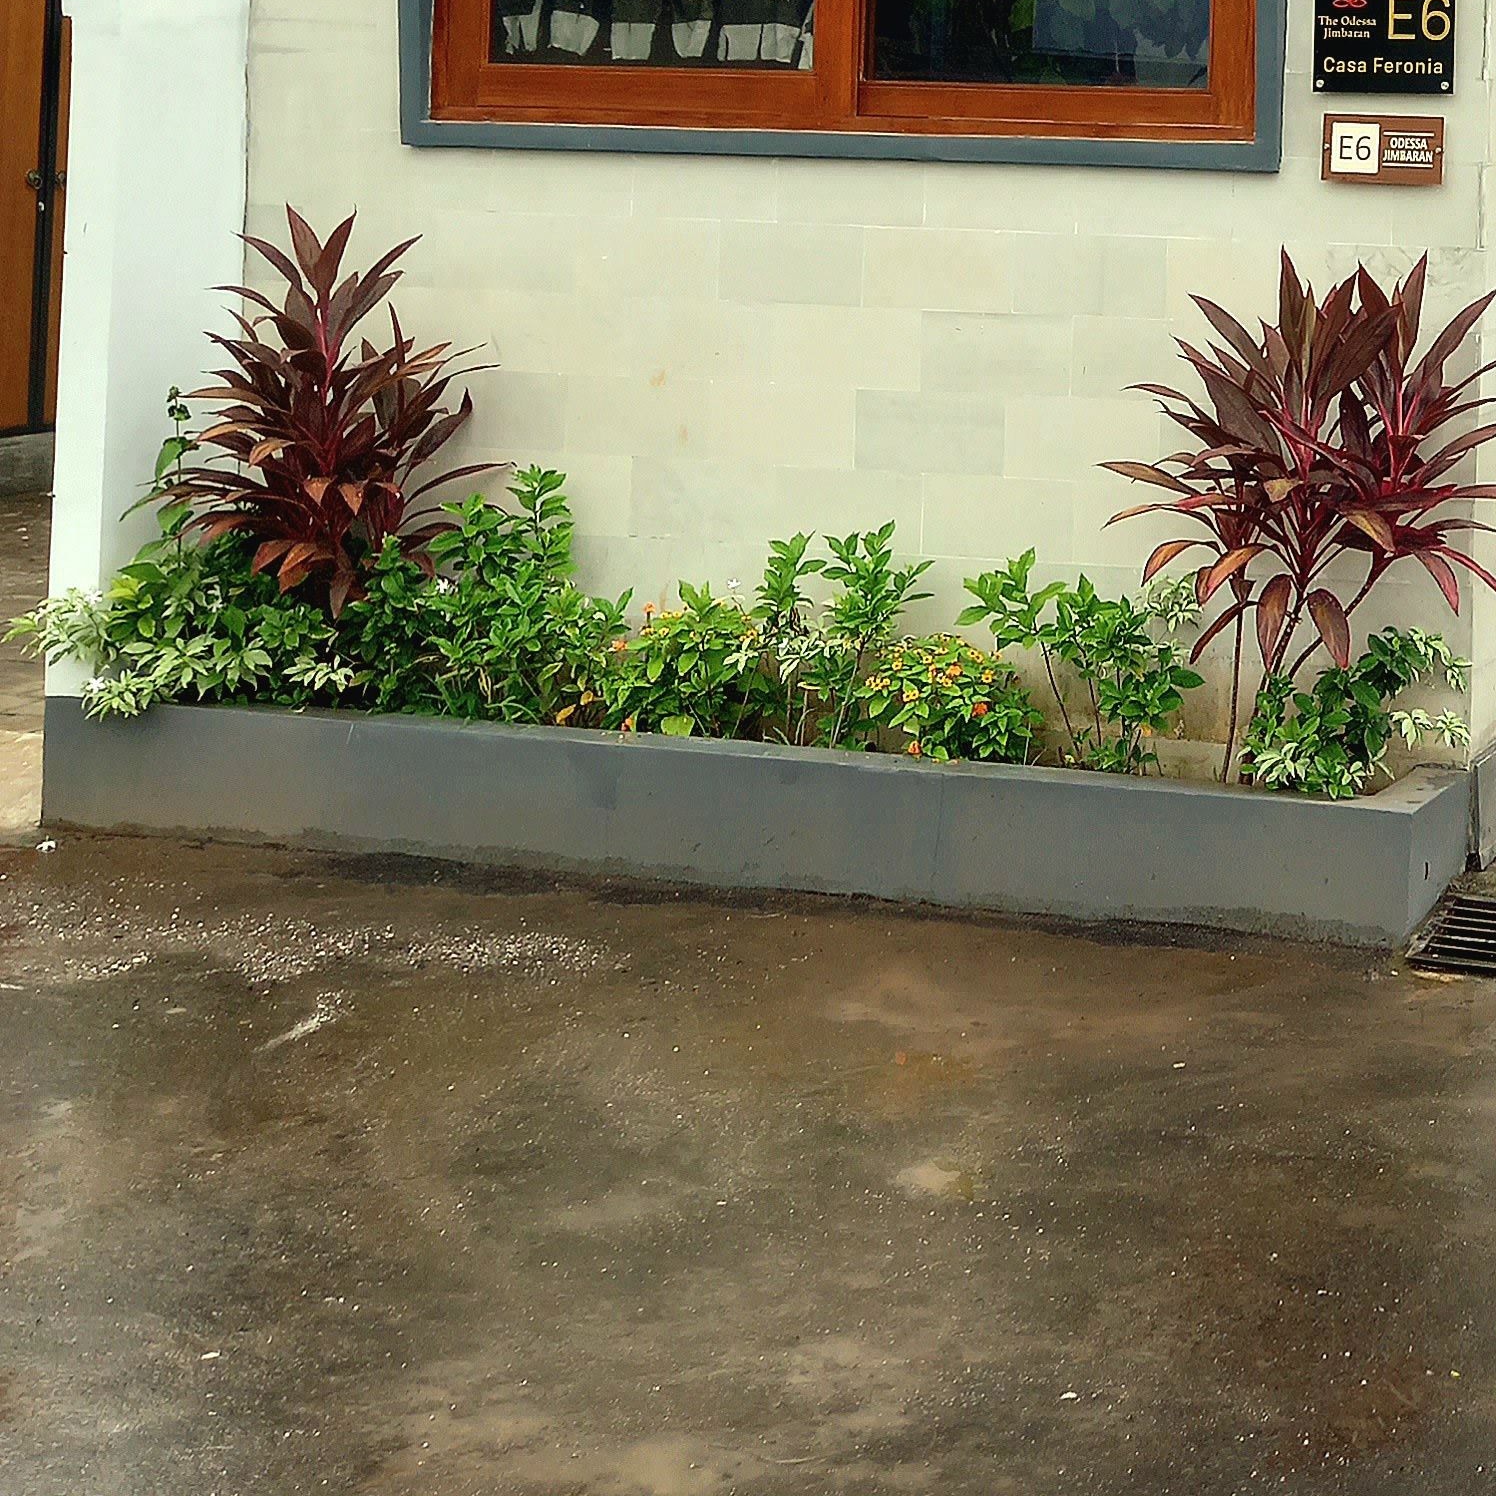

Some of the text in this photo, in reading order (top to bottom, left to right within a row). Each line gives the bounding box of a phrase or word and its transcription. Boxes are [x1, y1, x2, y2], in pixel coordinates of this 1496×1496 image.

[1317, 15, 1377, 27] The Odessa
[1323, 27, 1371, 39] Jimbaran
[1323, 56, 1443, 75] Casa Feronia
[1338, 135, 1372, 161] E6
[1389, 136, 1429, 150] ODESSA
[1382, 149, 1434, 163] JIMBARAN
